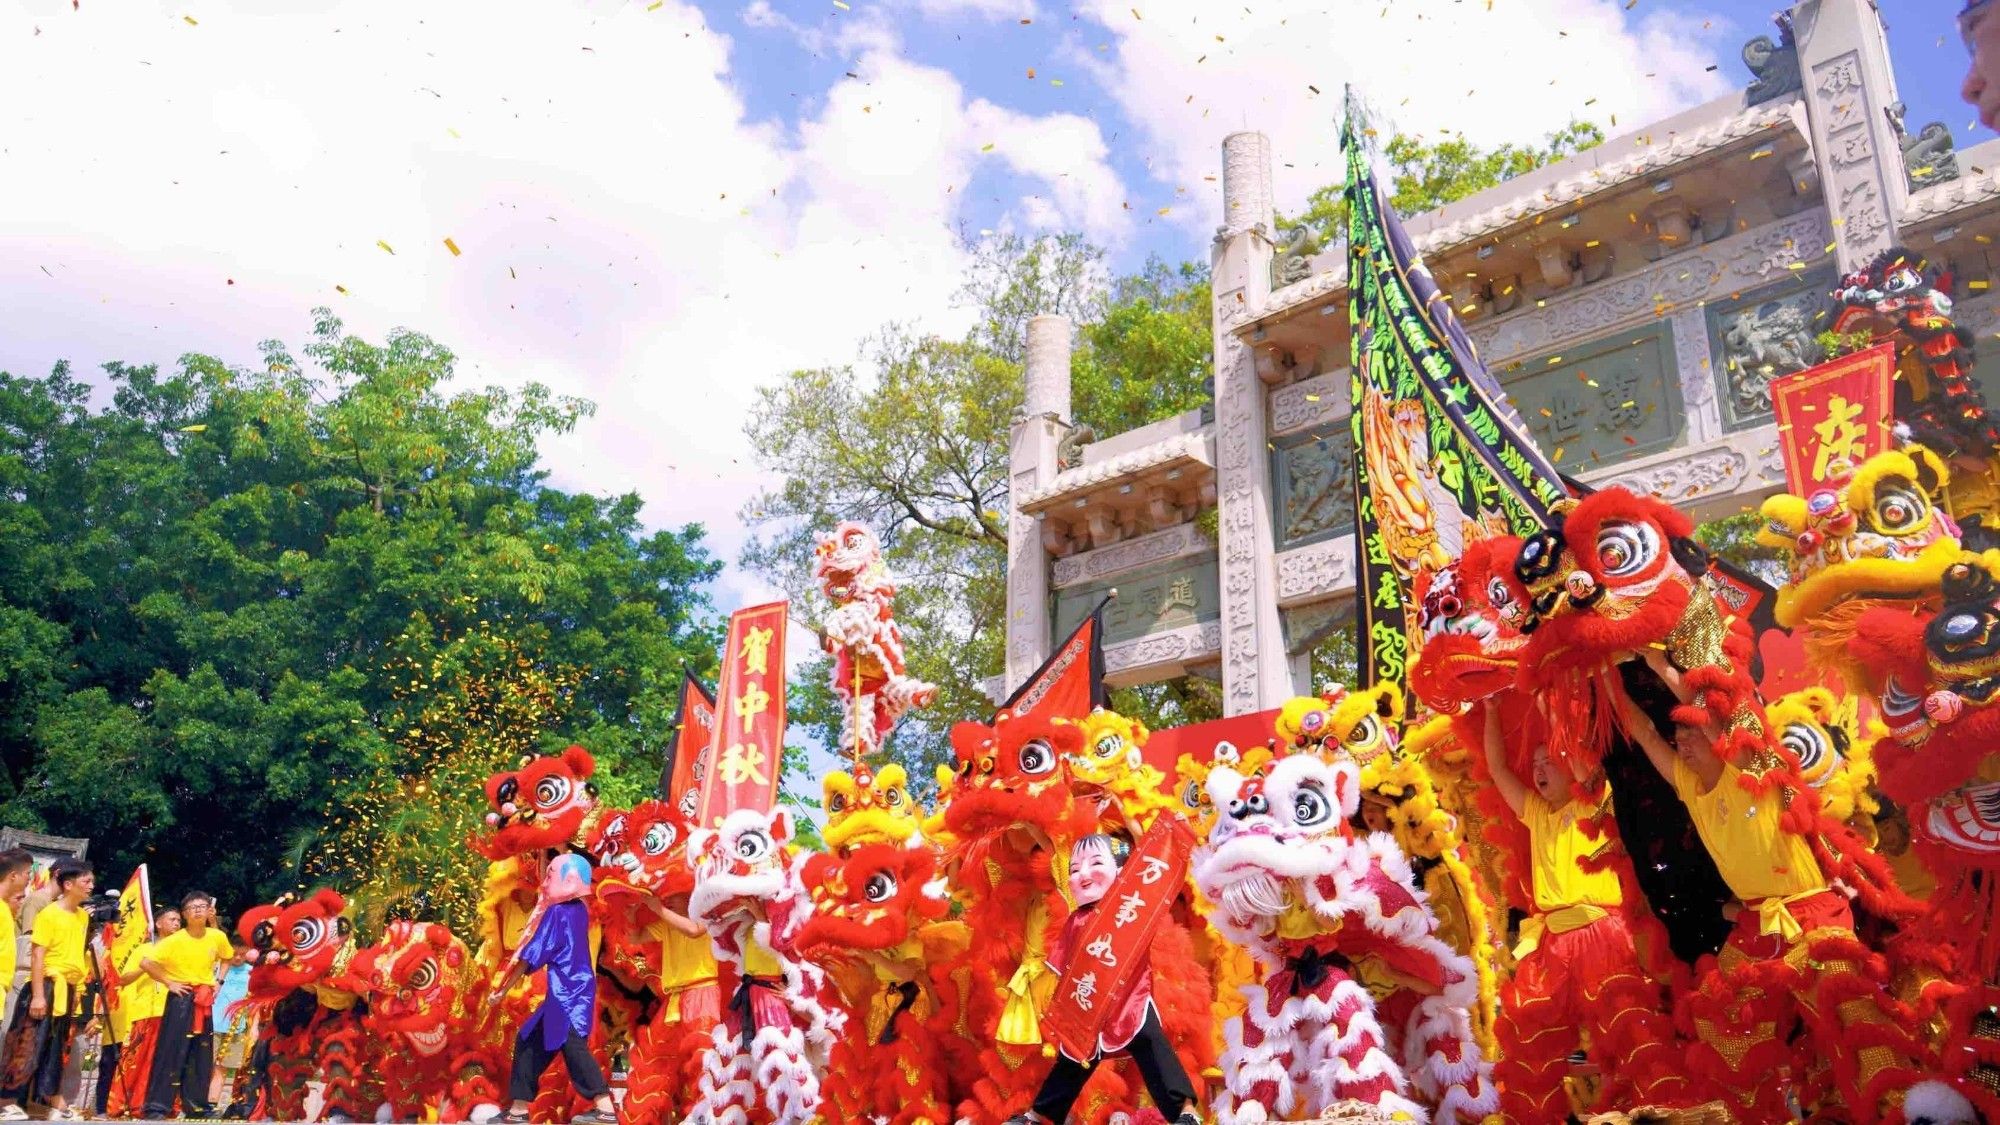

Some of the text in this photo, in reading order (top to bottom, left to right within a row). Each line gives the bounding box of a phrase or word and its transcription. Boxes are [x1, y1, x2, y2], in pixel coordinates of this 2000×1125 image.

[718, 626, 774, 785] 賀中秋
[1070, 856, 1170, 1011] 万事如意
